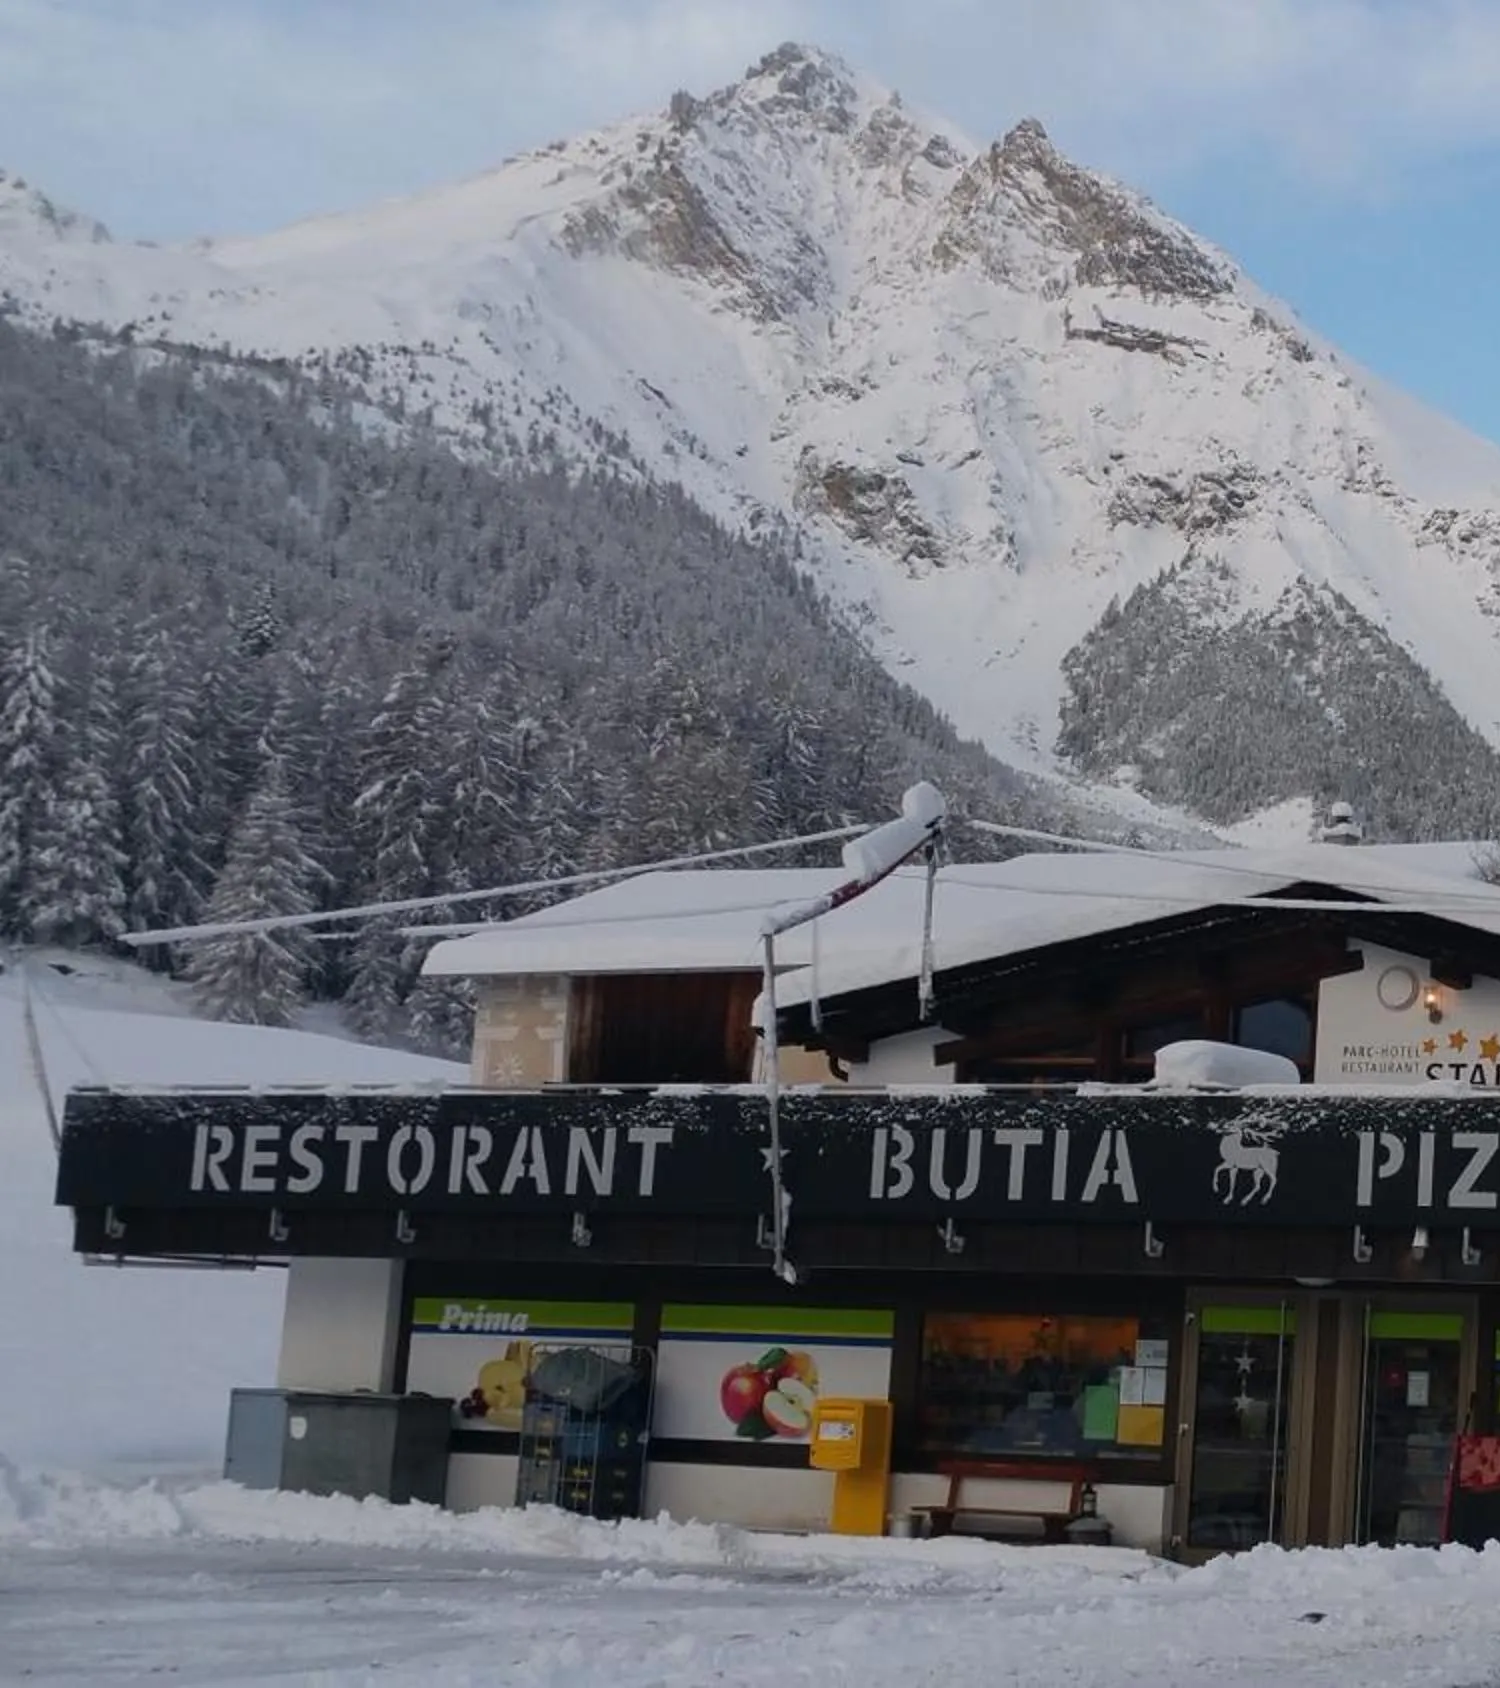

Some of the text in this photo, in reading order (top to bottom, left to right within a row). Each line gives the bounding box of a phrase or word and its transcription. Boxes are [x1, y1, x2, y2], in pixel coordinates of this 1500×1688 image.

[1341, 1062, 1420, 1074] RESTAURANT
[190, 1125, 673, 1196] RESTORANT
[869, 1125, 1139, 1203] BUTIA
[439, 1304, 529, 1332] Prima
